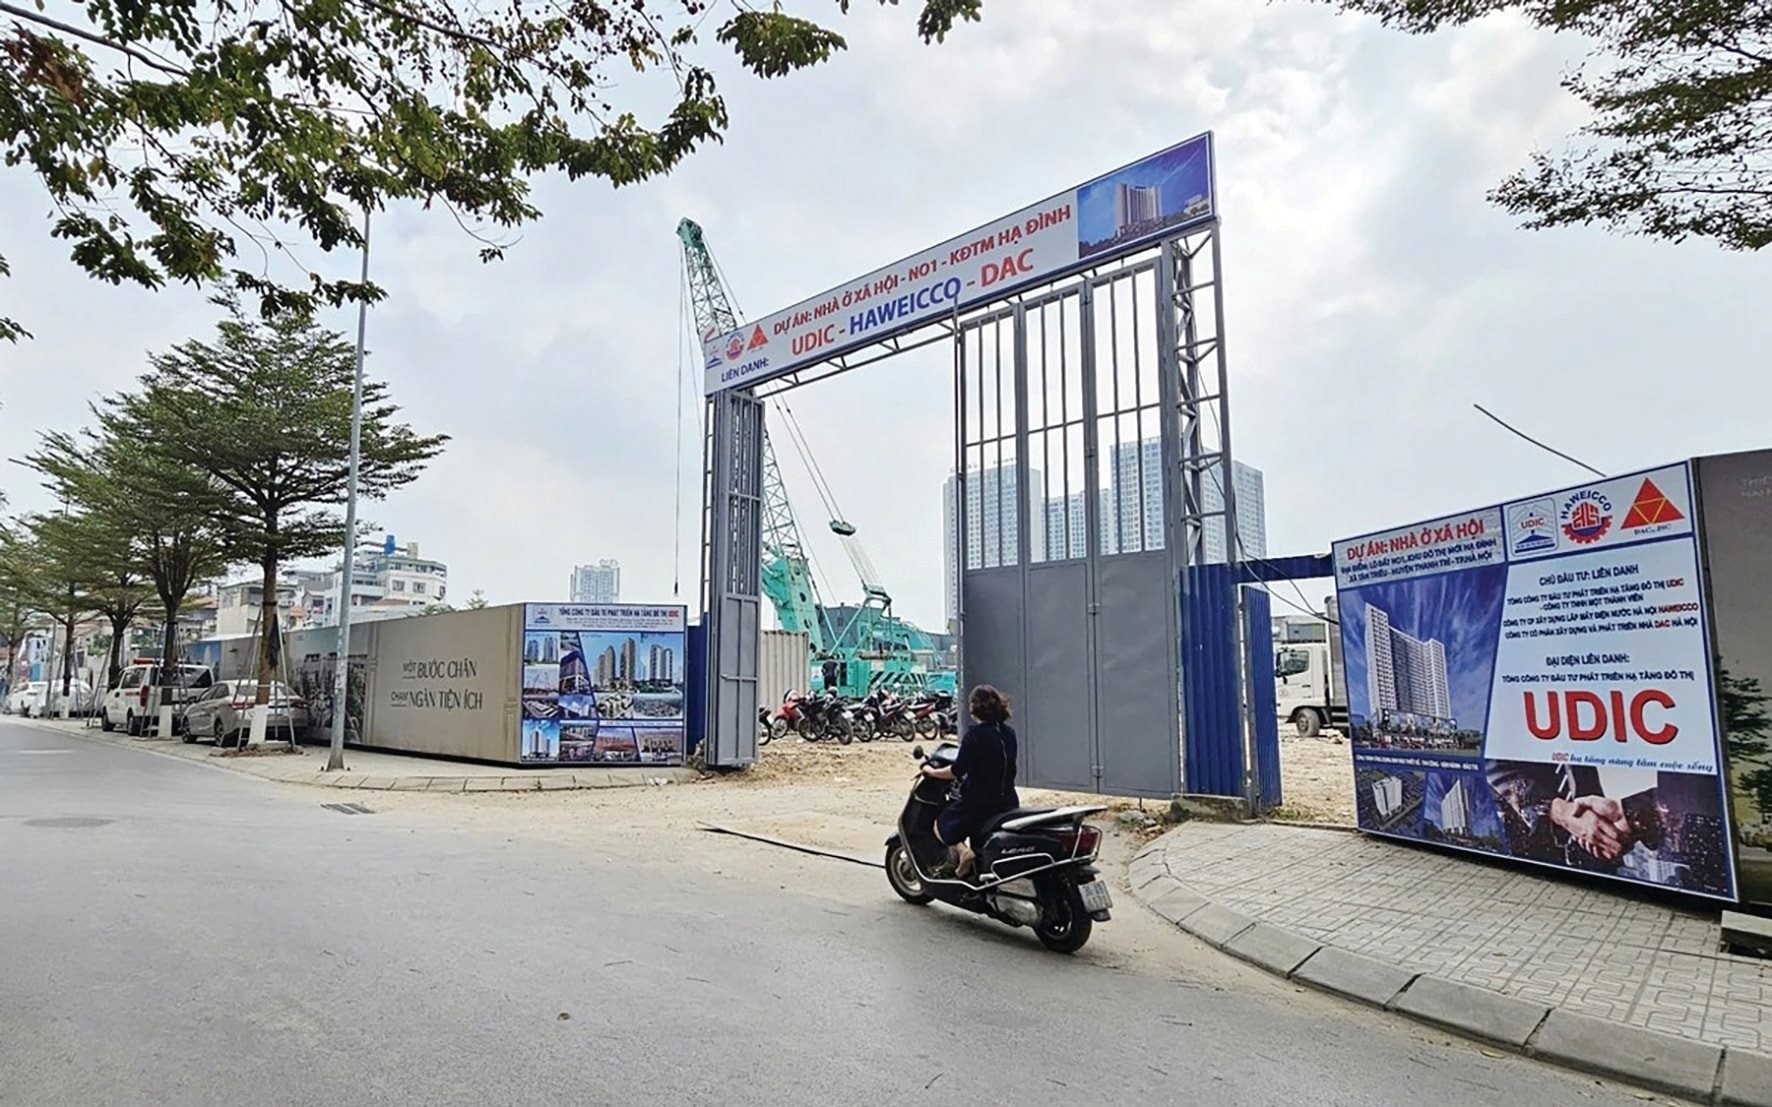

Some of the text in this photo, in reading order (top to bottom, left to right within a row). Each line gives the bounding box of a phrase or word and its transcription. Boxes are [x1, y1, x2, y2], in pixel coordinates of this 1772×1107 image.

[774, 316, 793, 335] DỰ
[793, 311, 812, 328] ÁN:
[814, 297, 840, 319] NHÀ
[842, 290, 853, 307] Ở
[854, 283, 871, 303] XÃ
[874, 274, 899, 295] HỘI
[950, 236, 995, 265] KĐTM
[998, 225, 1022, 246] HẠ
[1025, 204, 1070, 235] ĐÌNH
[792, 324, 835, 355] UDIC
[850, 276, 961, 335] HAWEICCO
[981, 248, 1034, 287] DAC
[721, 357, 769, 382] LIÊN DANH:
[1560, 490, 1612, 520] HAWEICCO
[1521, 518, 1544, 530] UDIC
[1347, 519, 1484, 563] DỰ ÁN: NHÀ Ở XÃ HỘI
[1539, 563, 1639, 586] CHỦ ĐẦU TƯ: LIÊN DANH
[418, 658, 446, 678] BƯỚC
[447, 658, 477, 678] CHÂN
[1546, 652, 1630, 667] ĐẠI DIỆN LIÊN DANH:
[1502, 668, 1694, 683] TỔNG CÔNG TY ĐẦU TƯ PHÁT TRIỂN HẠ TẦNG ĐÔ THỊ
[409, 688, 436, 707] NGÀN
[439, 688, 461, 712] TIỆN
[464, 688, 483, 710] ÍCH
[1523, 689, 1679, 745] UDIC
